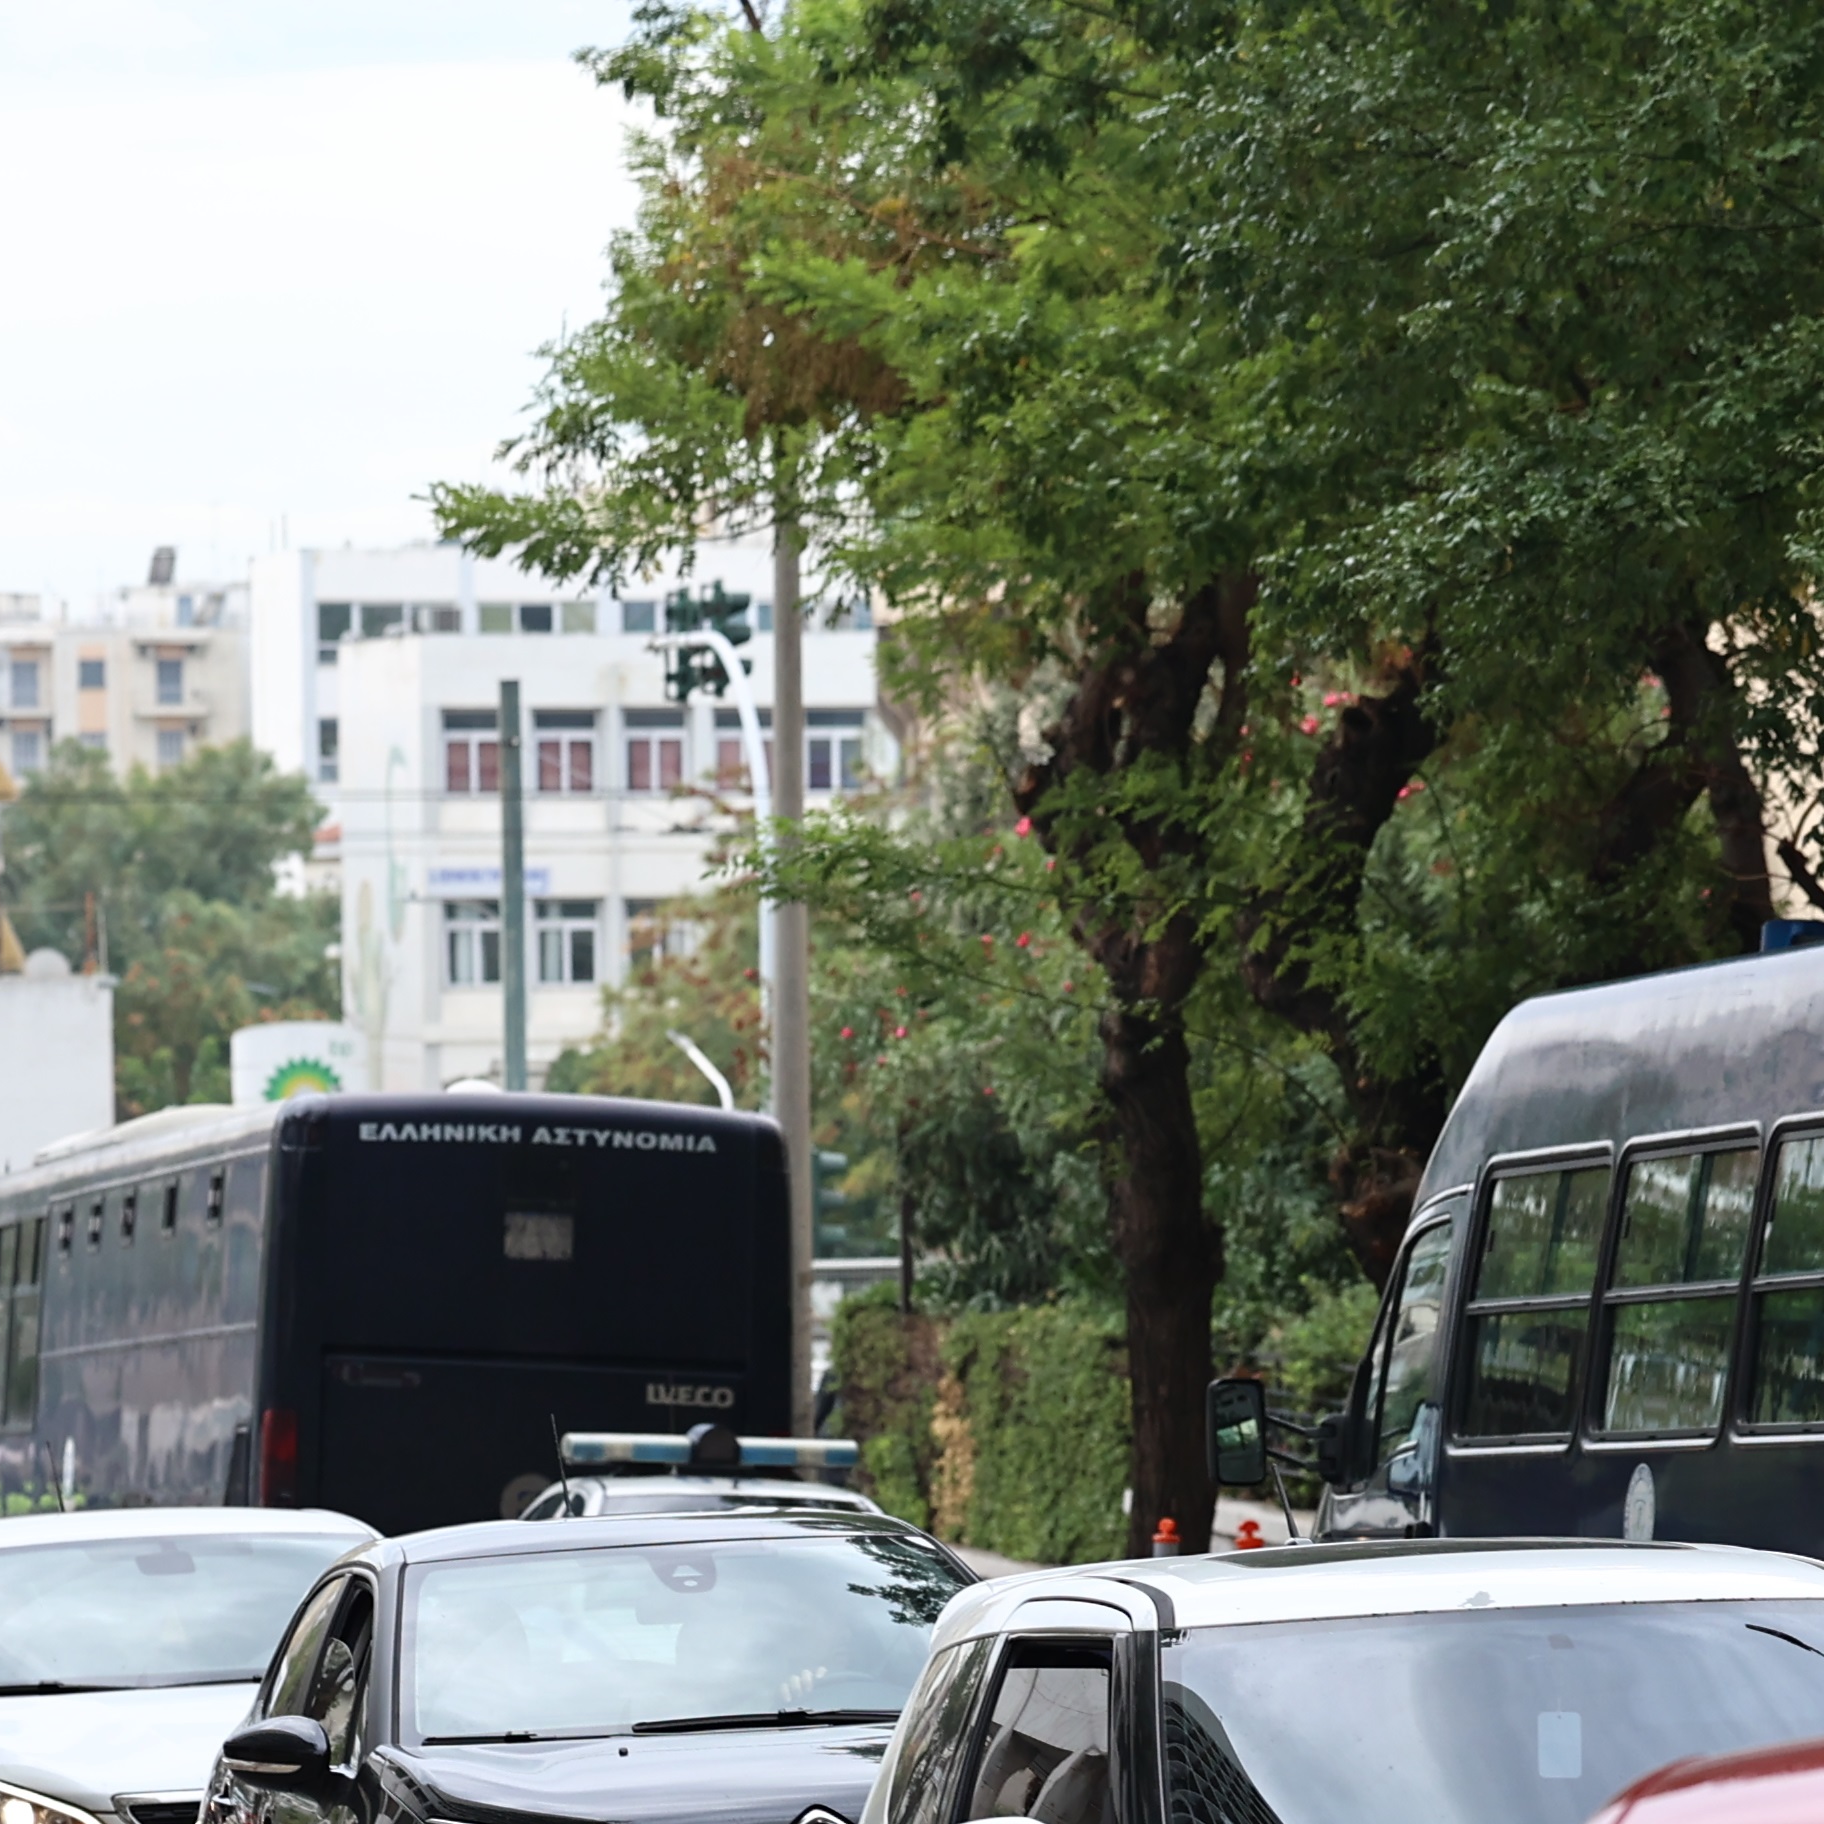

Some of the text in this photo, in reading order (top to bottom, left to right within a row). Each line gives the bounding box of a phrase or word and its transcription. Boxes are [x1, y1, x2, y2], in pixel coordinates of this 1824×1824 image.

[358, 1123, 717, 1153] ΕΛΛΗΝΙΚΗ ΑΣΤΥΝΟΜΙΑ
[645, 1383, 735, 1408] IVECO
